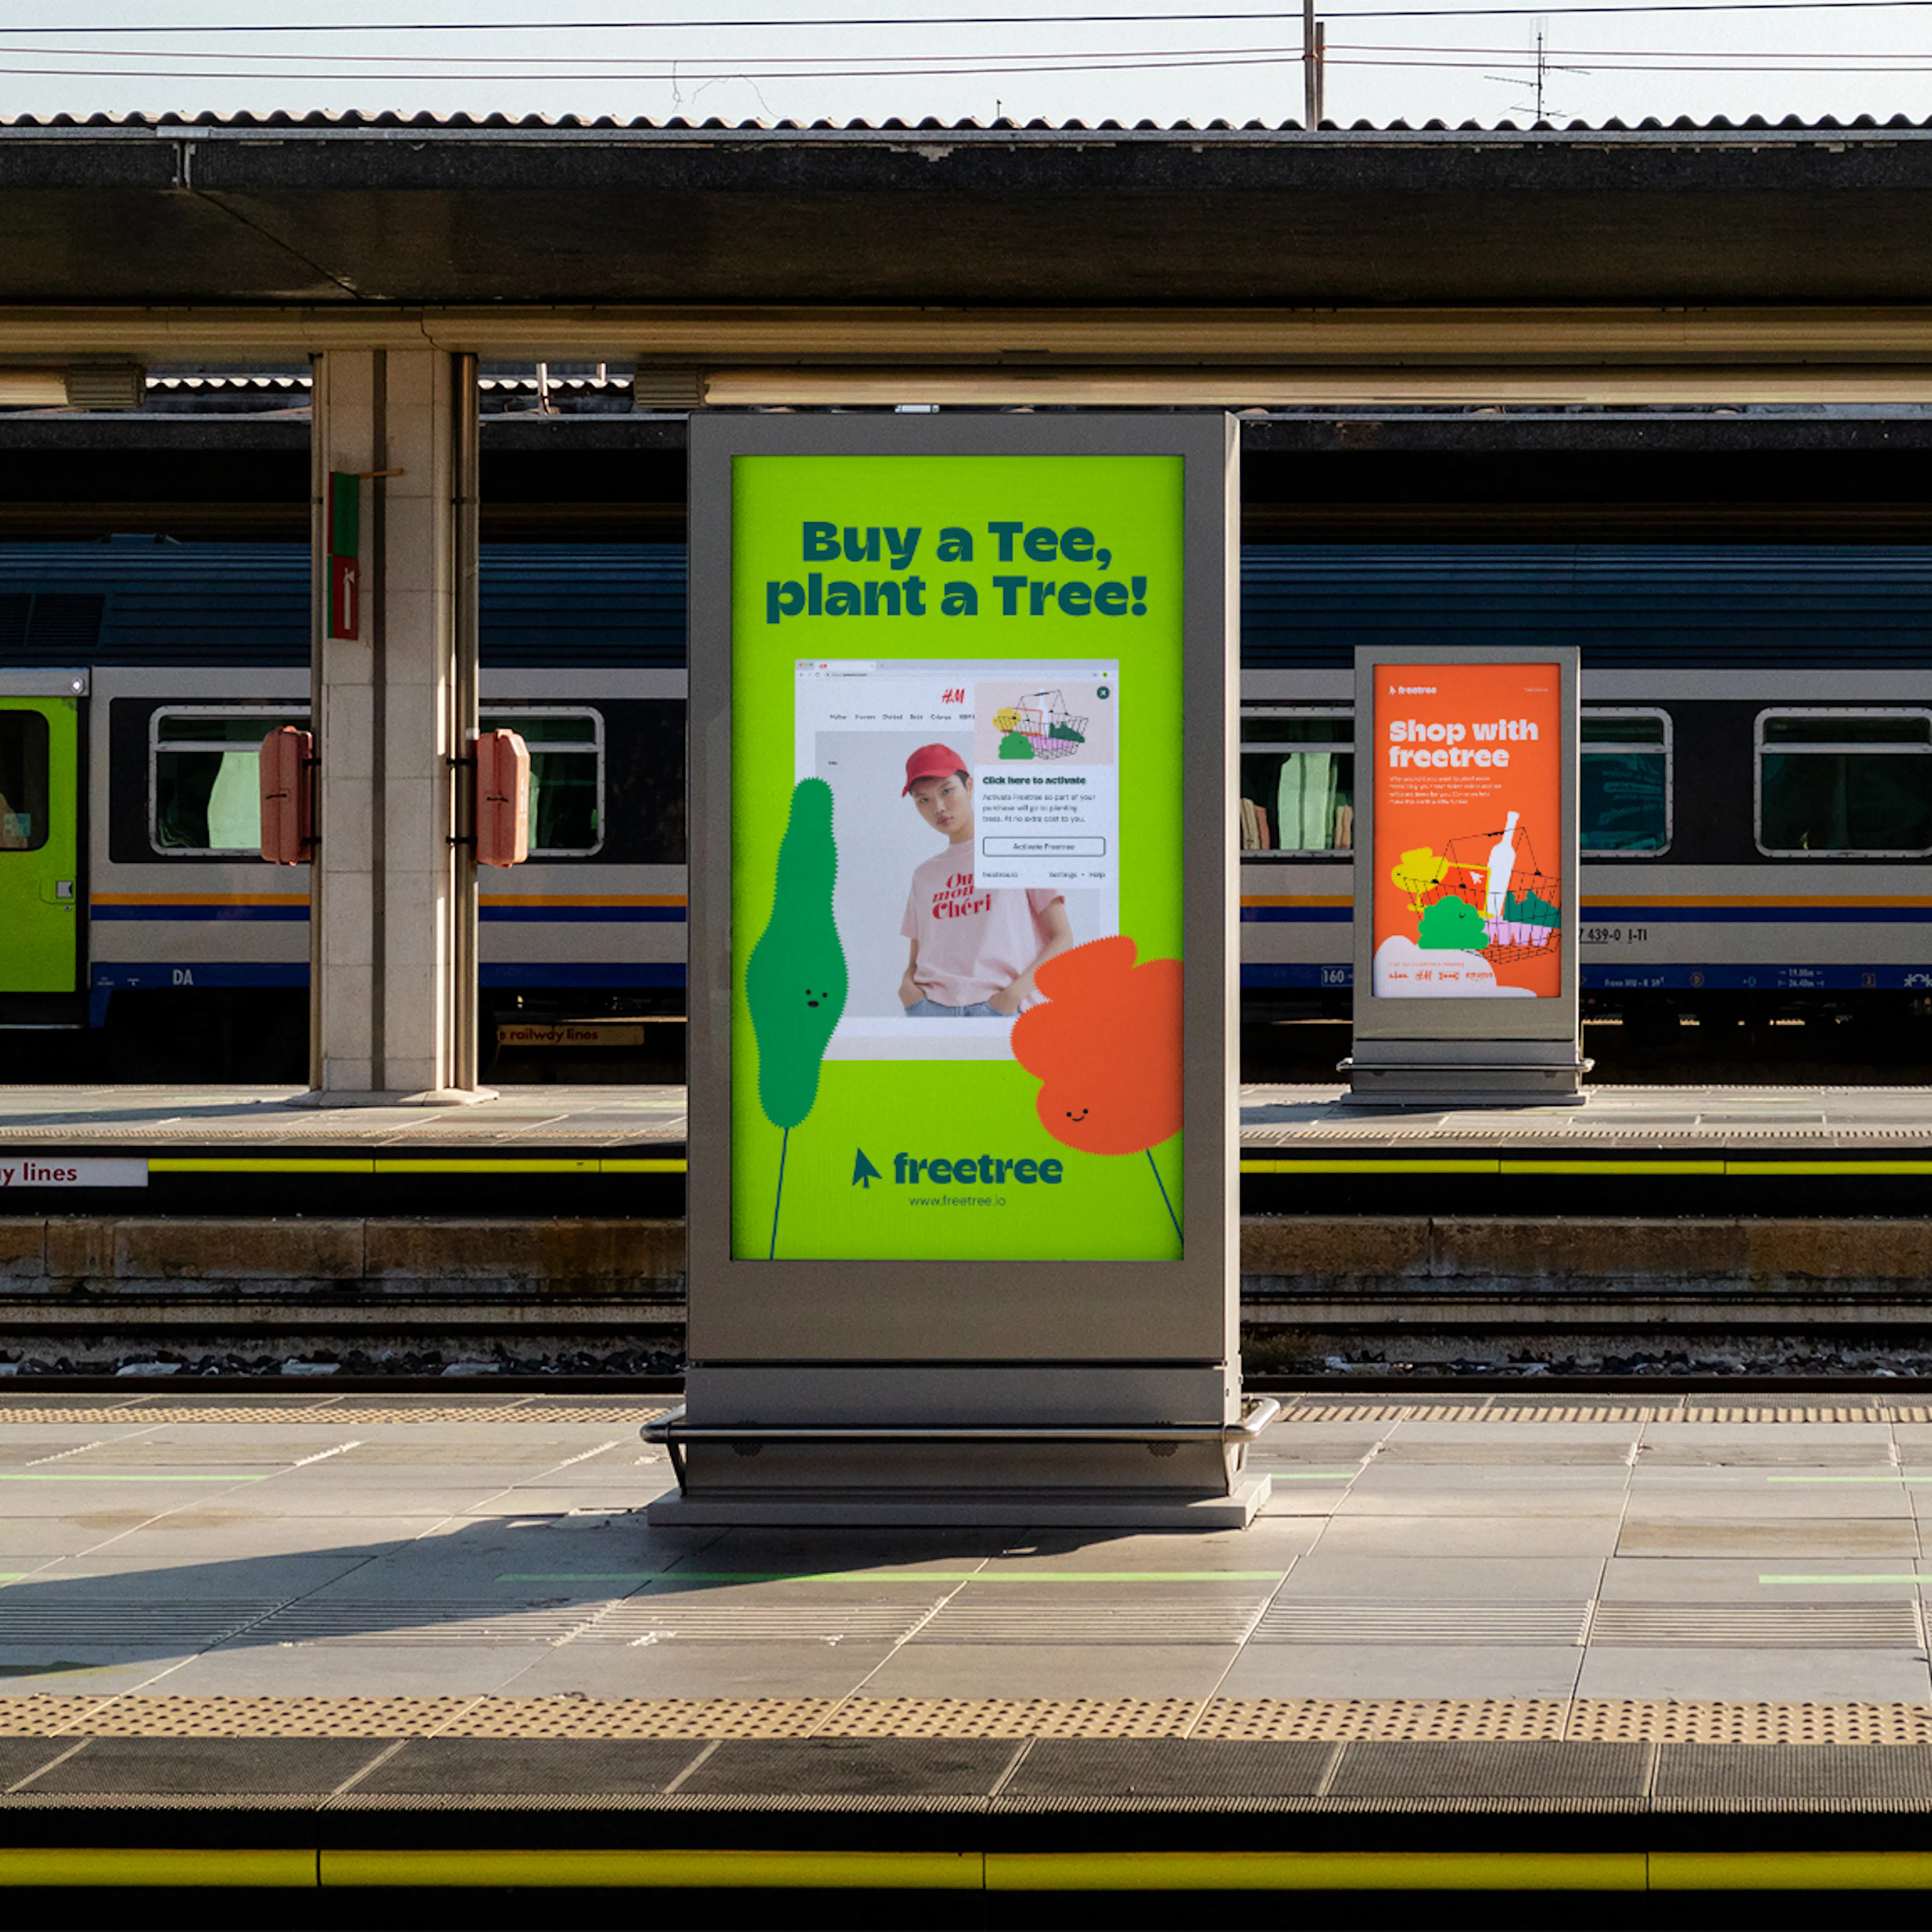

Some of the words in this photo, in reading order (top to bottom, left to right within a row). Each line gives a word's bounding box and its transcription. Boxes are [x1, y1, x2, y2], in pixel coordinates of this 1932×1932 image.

[803, 521, 922, 570] Buy
[936, 527, 973, 562] a
[988, 521, 1112, 570] Tee,
[766, 573, 926, 624] plant
[941, 581, 978, 616] a
[992, 576, 1148, 616] Tree!
[1389, 718, 1467, 745] Shop
[1472, 718, 1539, 741] with
[1389, 746, 1510, 768] freetree
[983, 776, 1006, 784] Click
[1008, 776, 1030, 784] here
[1033, 776, 1043, 784] to
[1045, 776, 1086, 784] activate
[1588, 929, 1621, 941] 439-0
[172, 969, 194, 986] DA
[1324, 970, 1344, 984] 160
[510, 1028, 563, 1043] railway
[567, 1028, 599, 1040] lines
[0, 1168, 15, 1186] y
[23, 1162, 77, 1181] lines
[894, 1152, 1063, 1184] freetree
[909, 1194, 1006, 1207] www.freetree.io
